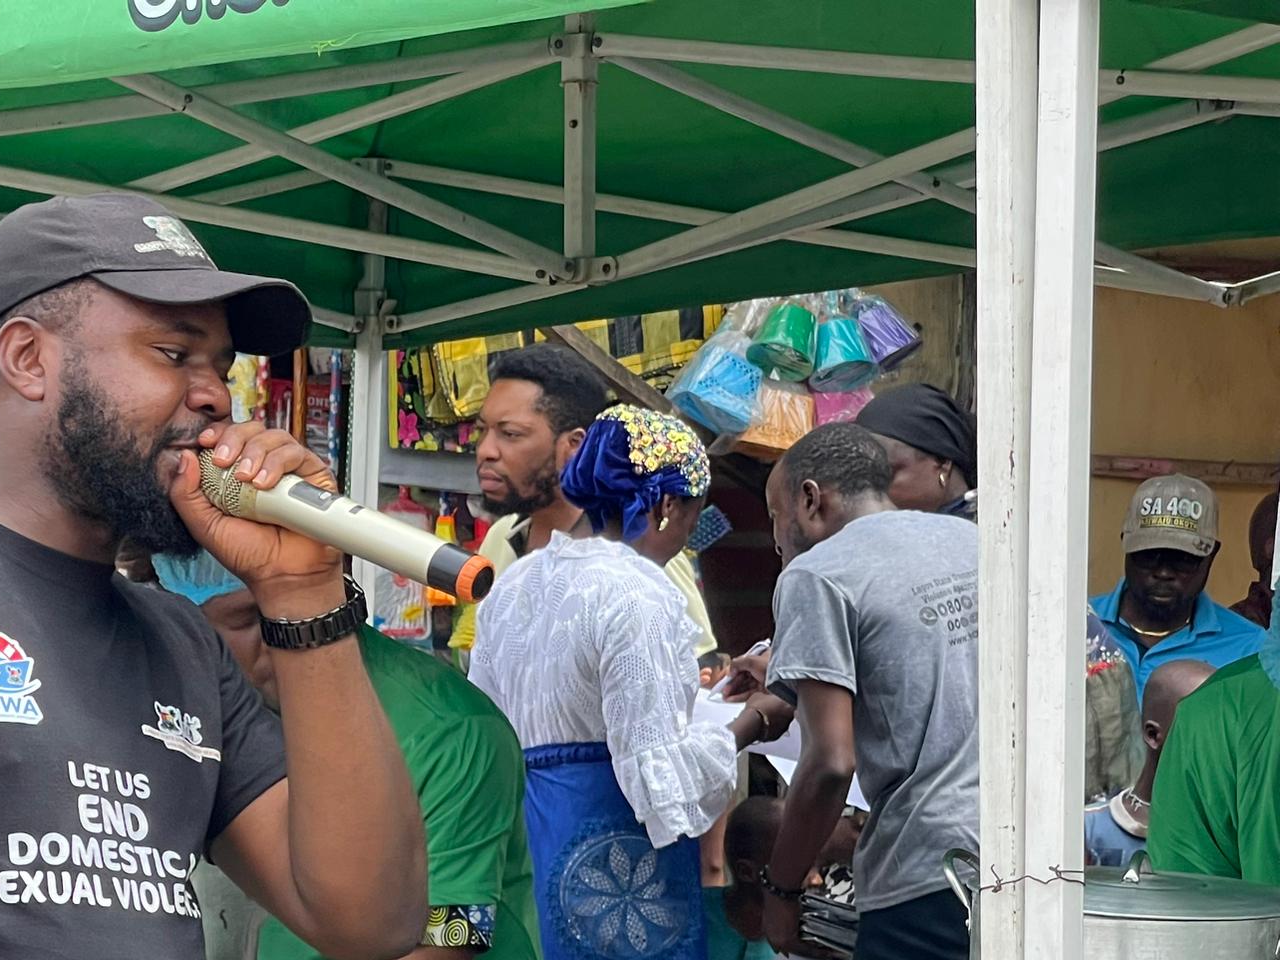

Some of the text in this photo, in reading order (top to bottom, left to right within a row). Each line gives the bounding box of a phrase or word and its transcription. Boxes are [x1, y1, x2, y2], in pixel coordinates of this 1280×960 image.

[1141, 497, 1202, 520] SA 400
[67, 760, 151, 799] LET US
[77, 793, 149, 841] END
[7, 832, 186, 878] DOMESTIC
